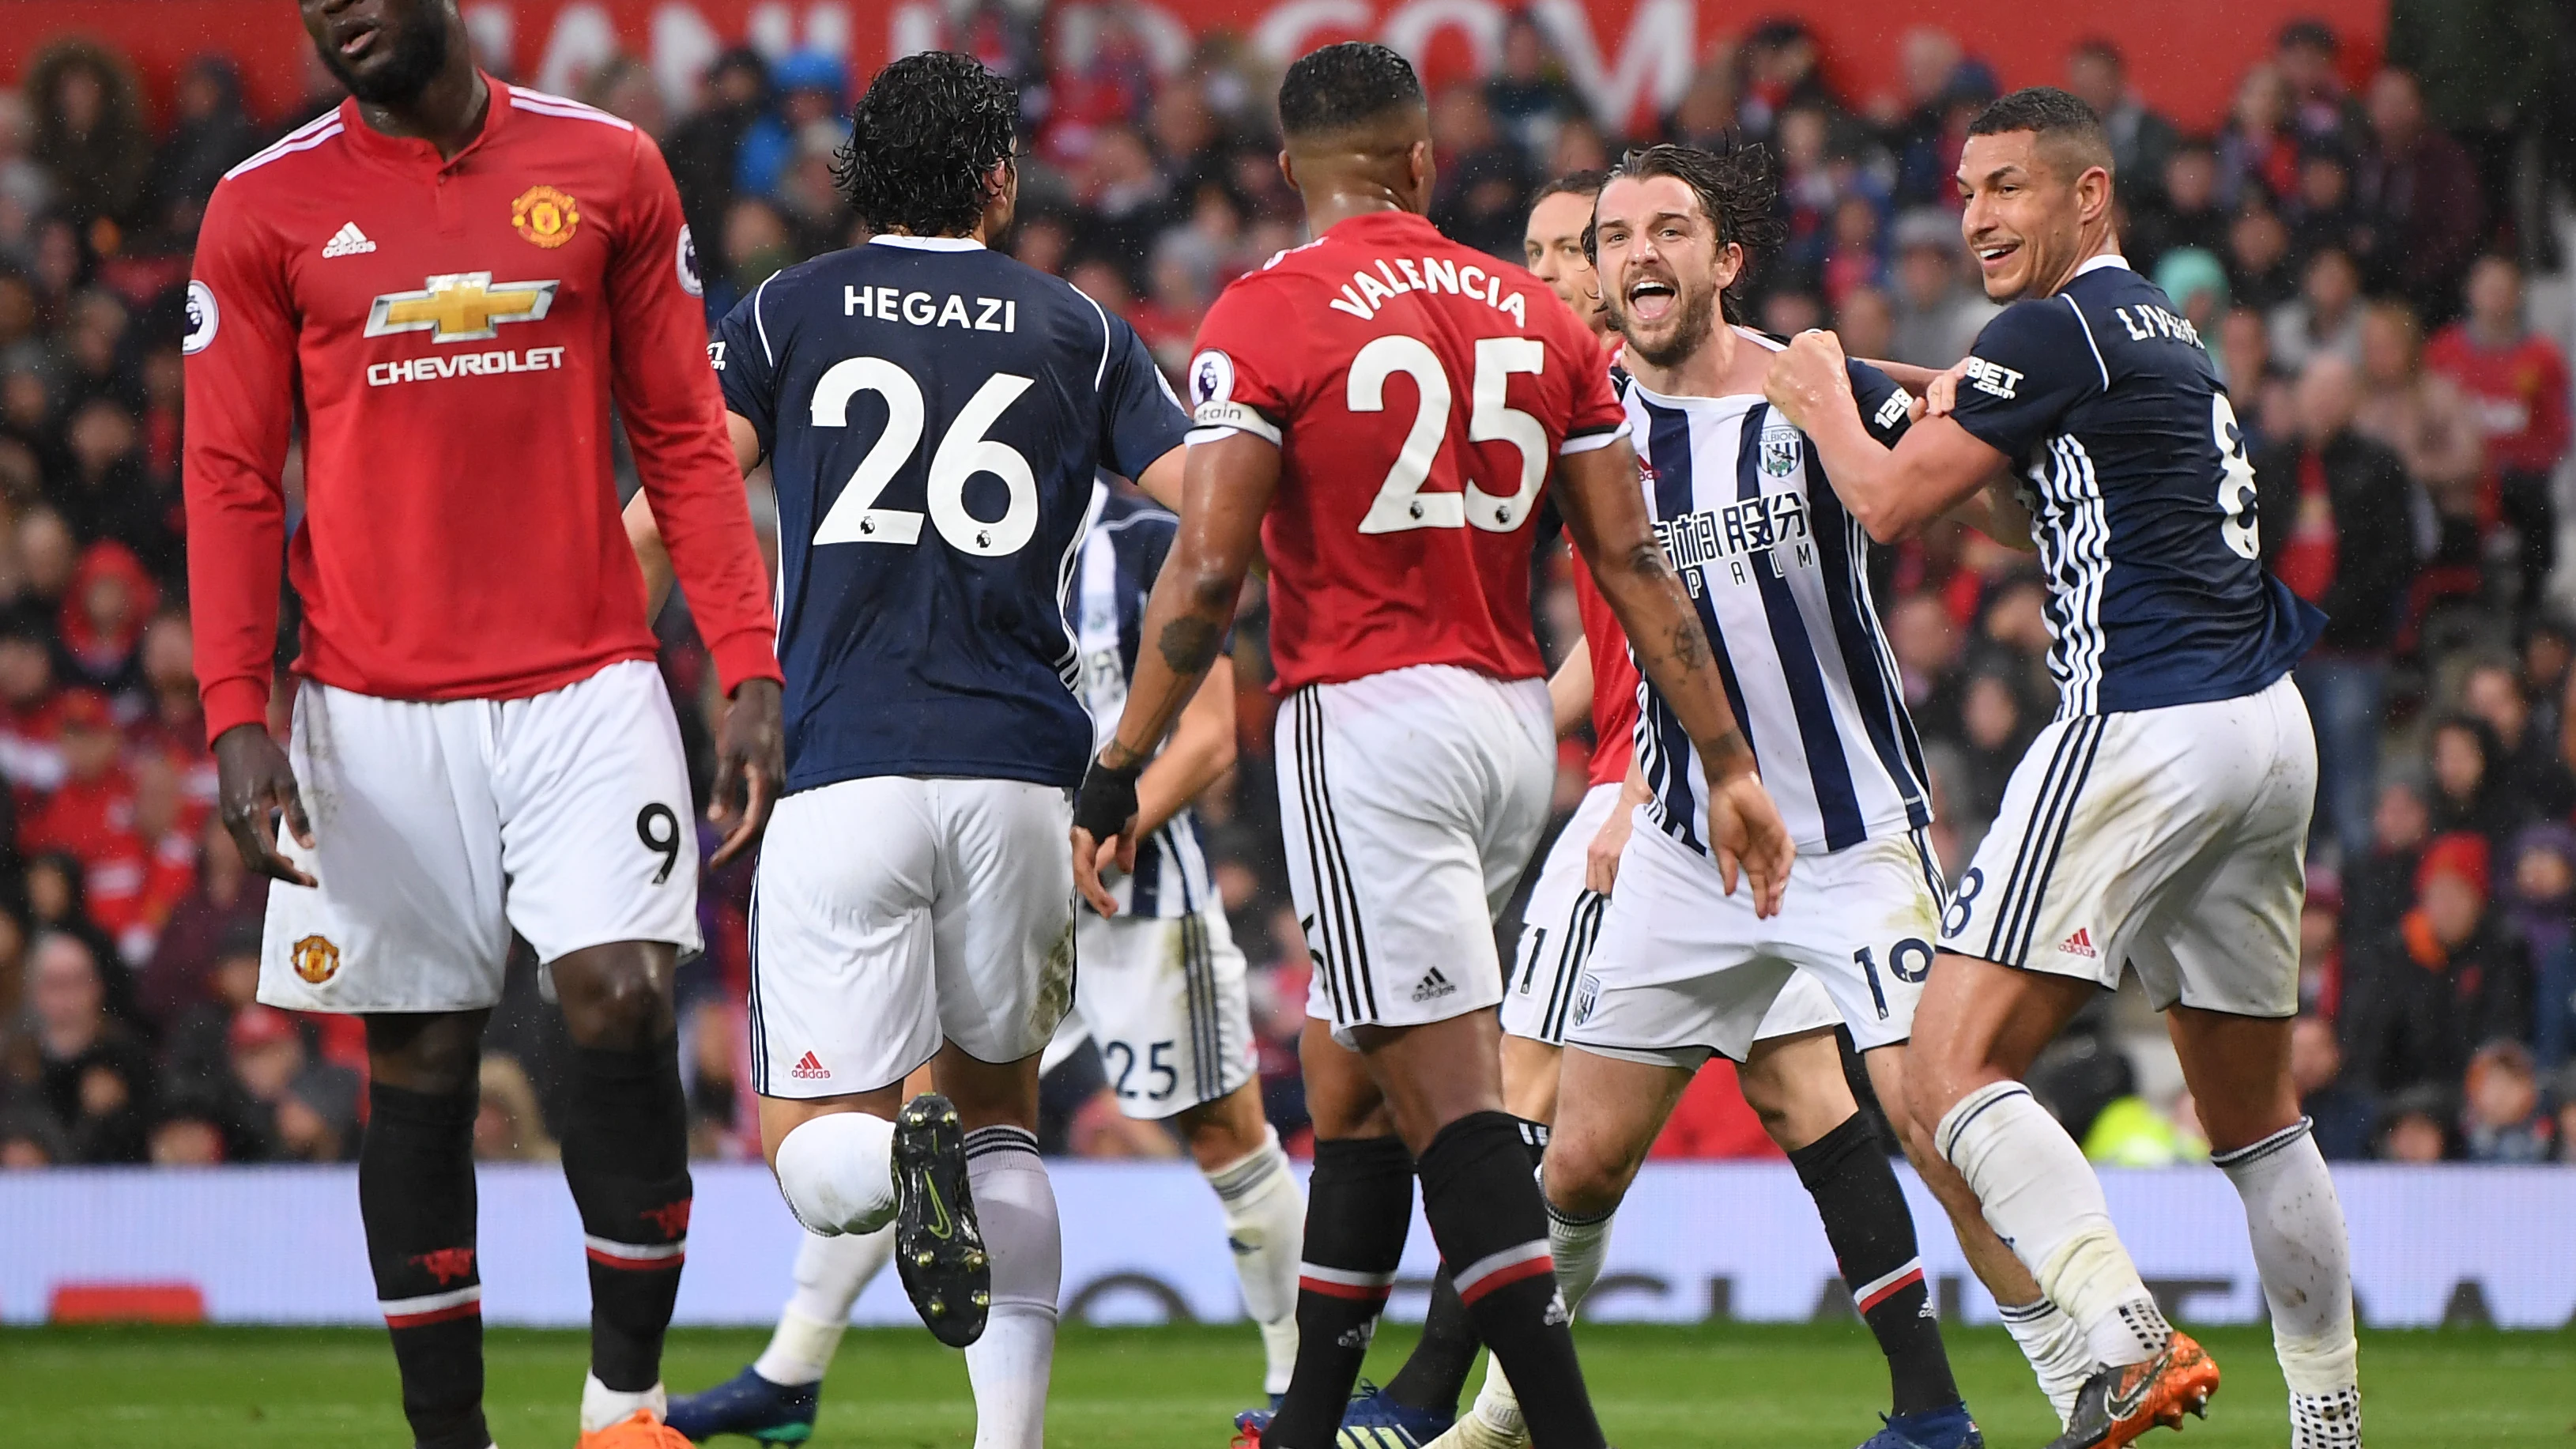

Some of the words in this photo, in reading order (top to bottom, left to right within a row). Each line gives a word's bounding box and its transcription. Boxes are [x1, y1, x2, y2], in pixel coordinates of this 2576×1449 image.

[322, 240, 377, 260] adidas
[843, 285, 1016, 334] HEGAZI
[1329, 257, 1526, 329] VALENCIA
[367, 345, 566, 387] CHEVROLET
[1972, 379, 2017, 400] .com
[810, 356, 1039, 557] 26
[1346, 334, 1549, 534] 25
[636, 802, 680, 885] 9
[1940, 866, 1985, 939] 8
[2057, 941, 2097, 959] adidas
[1411, 984, 1458, 1003] adidas
[790, 1067, 832, 1080] adidas
[1107, 1040, 1178, 1101] 25
